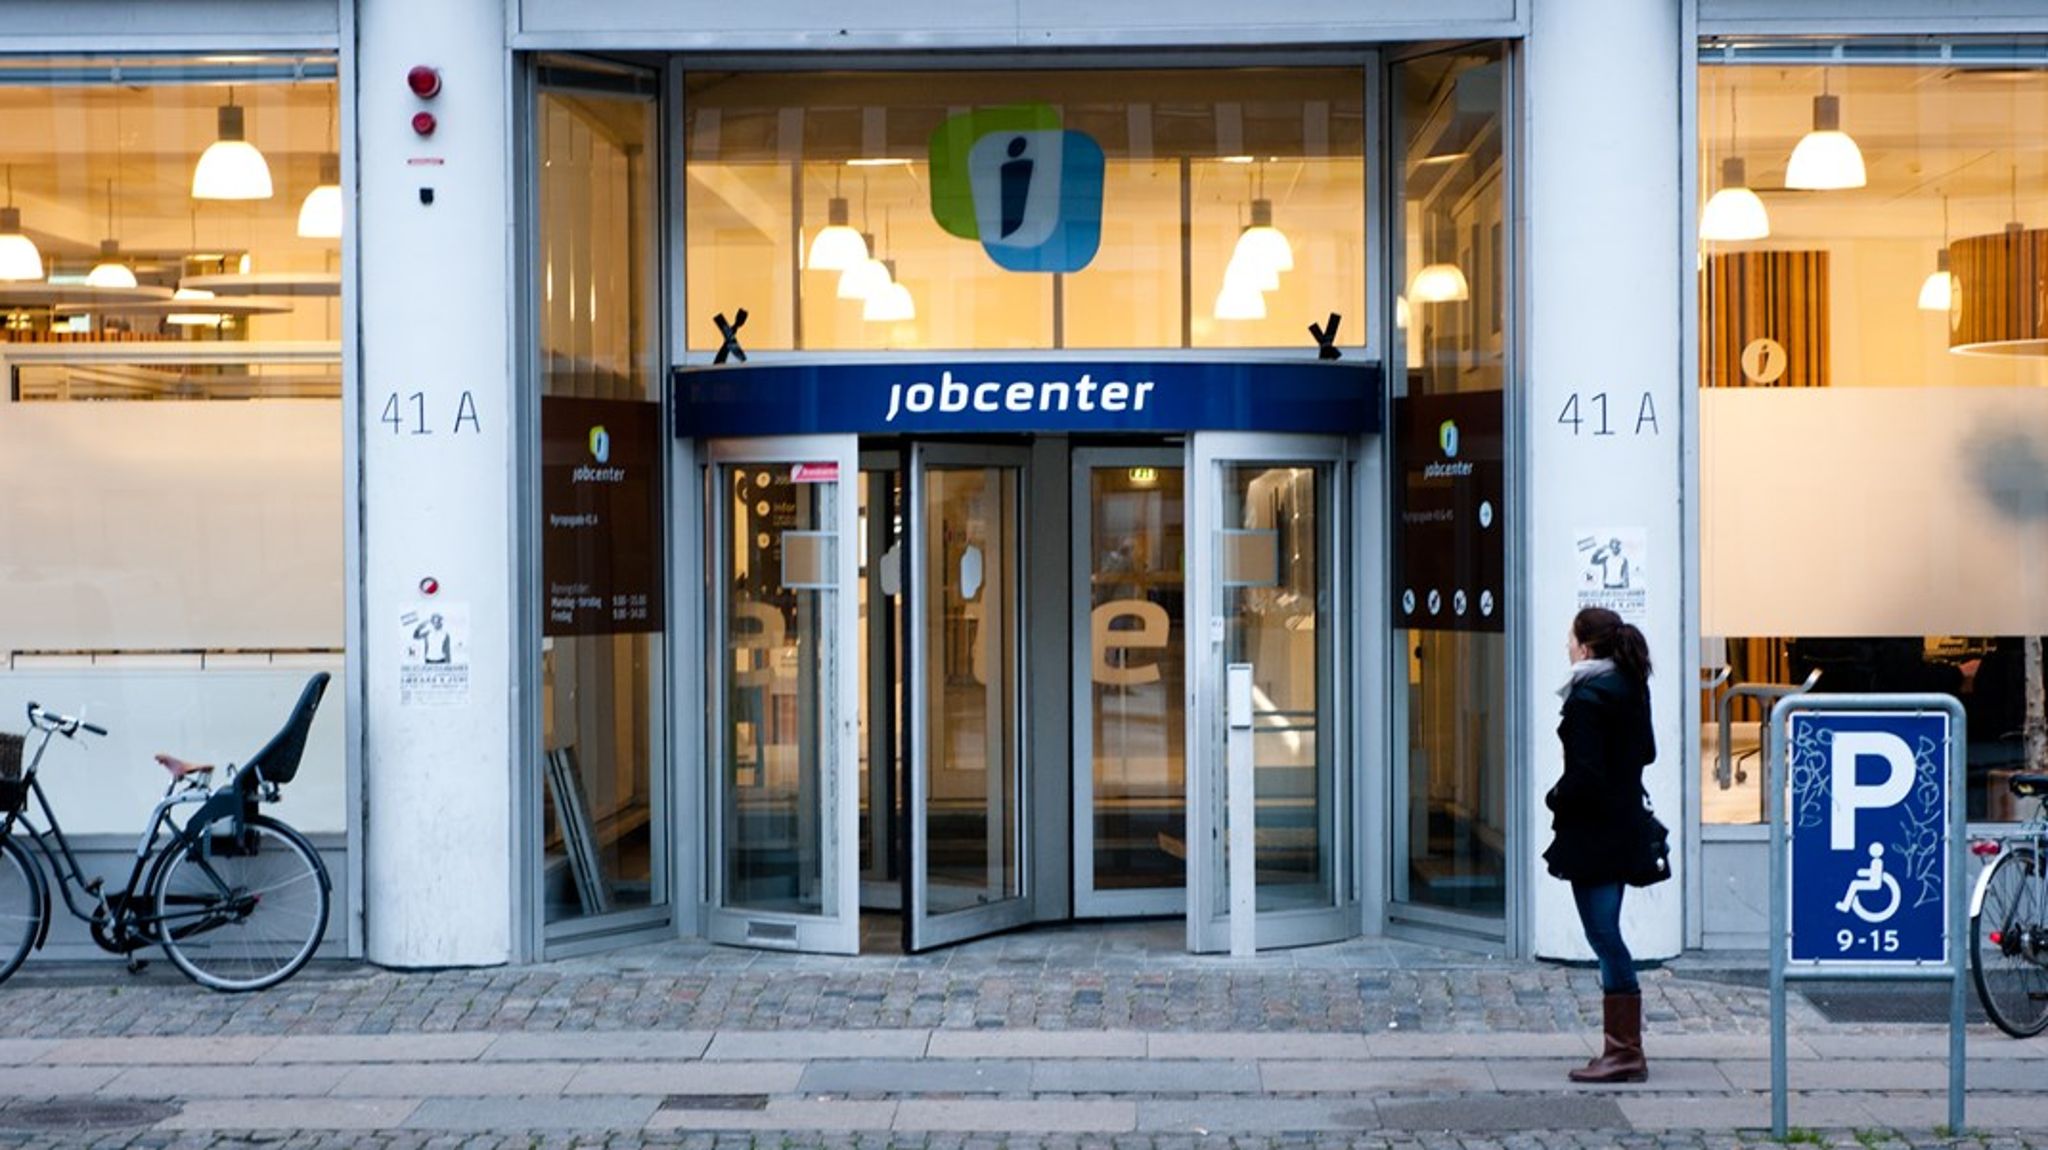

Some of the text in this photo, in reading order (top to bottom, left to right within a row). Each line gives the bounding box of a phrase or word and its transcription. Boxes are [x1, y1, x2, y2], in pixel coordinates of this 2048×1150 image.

[381, 390, 481, 435] 41 A
[885, 370, 1155, 422] jobcenter
[1558, 391, 1660, 436] 41 A
[572, 465, 625, 482] jobcenter
[1424, 461, 1473, 481] jobcenter
[1831, 731, 1917, 850] P
[1836, 929, 1900, 952] 9-15
